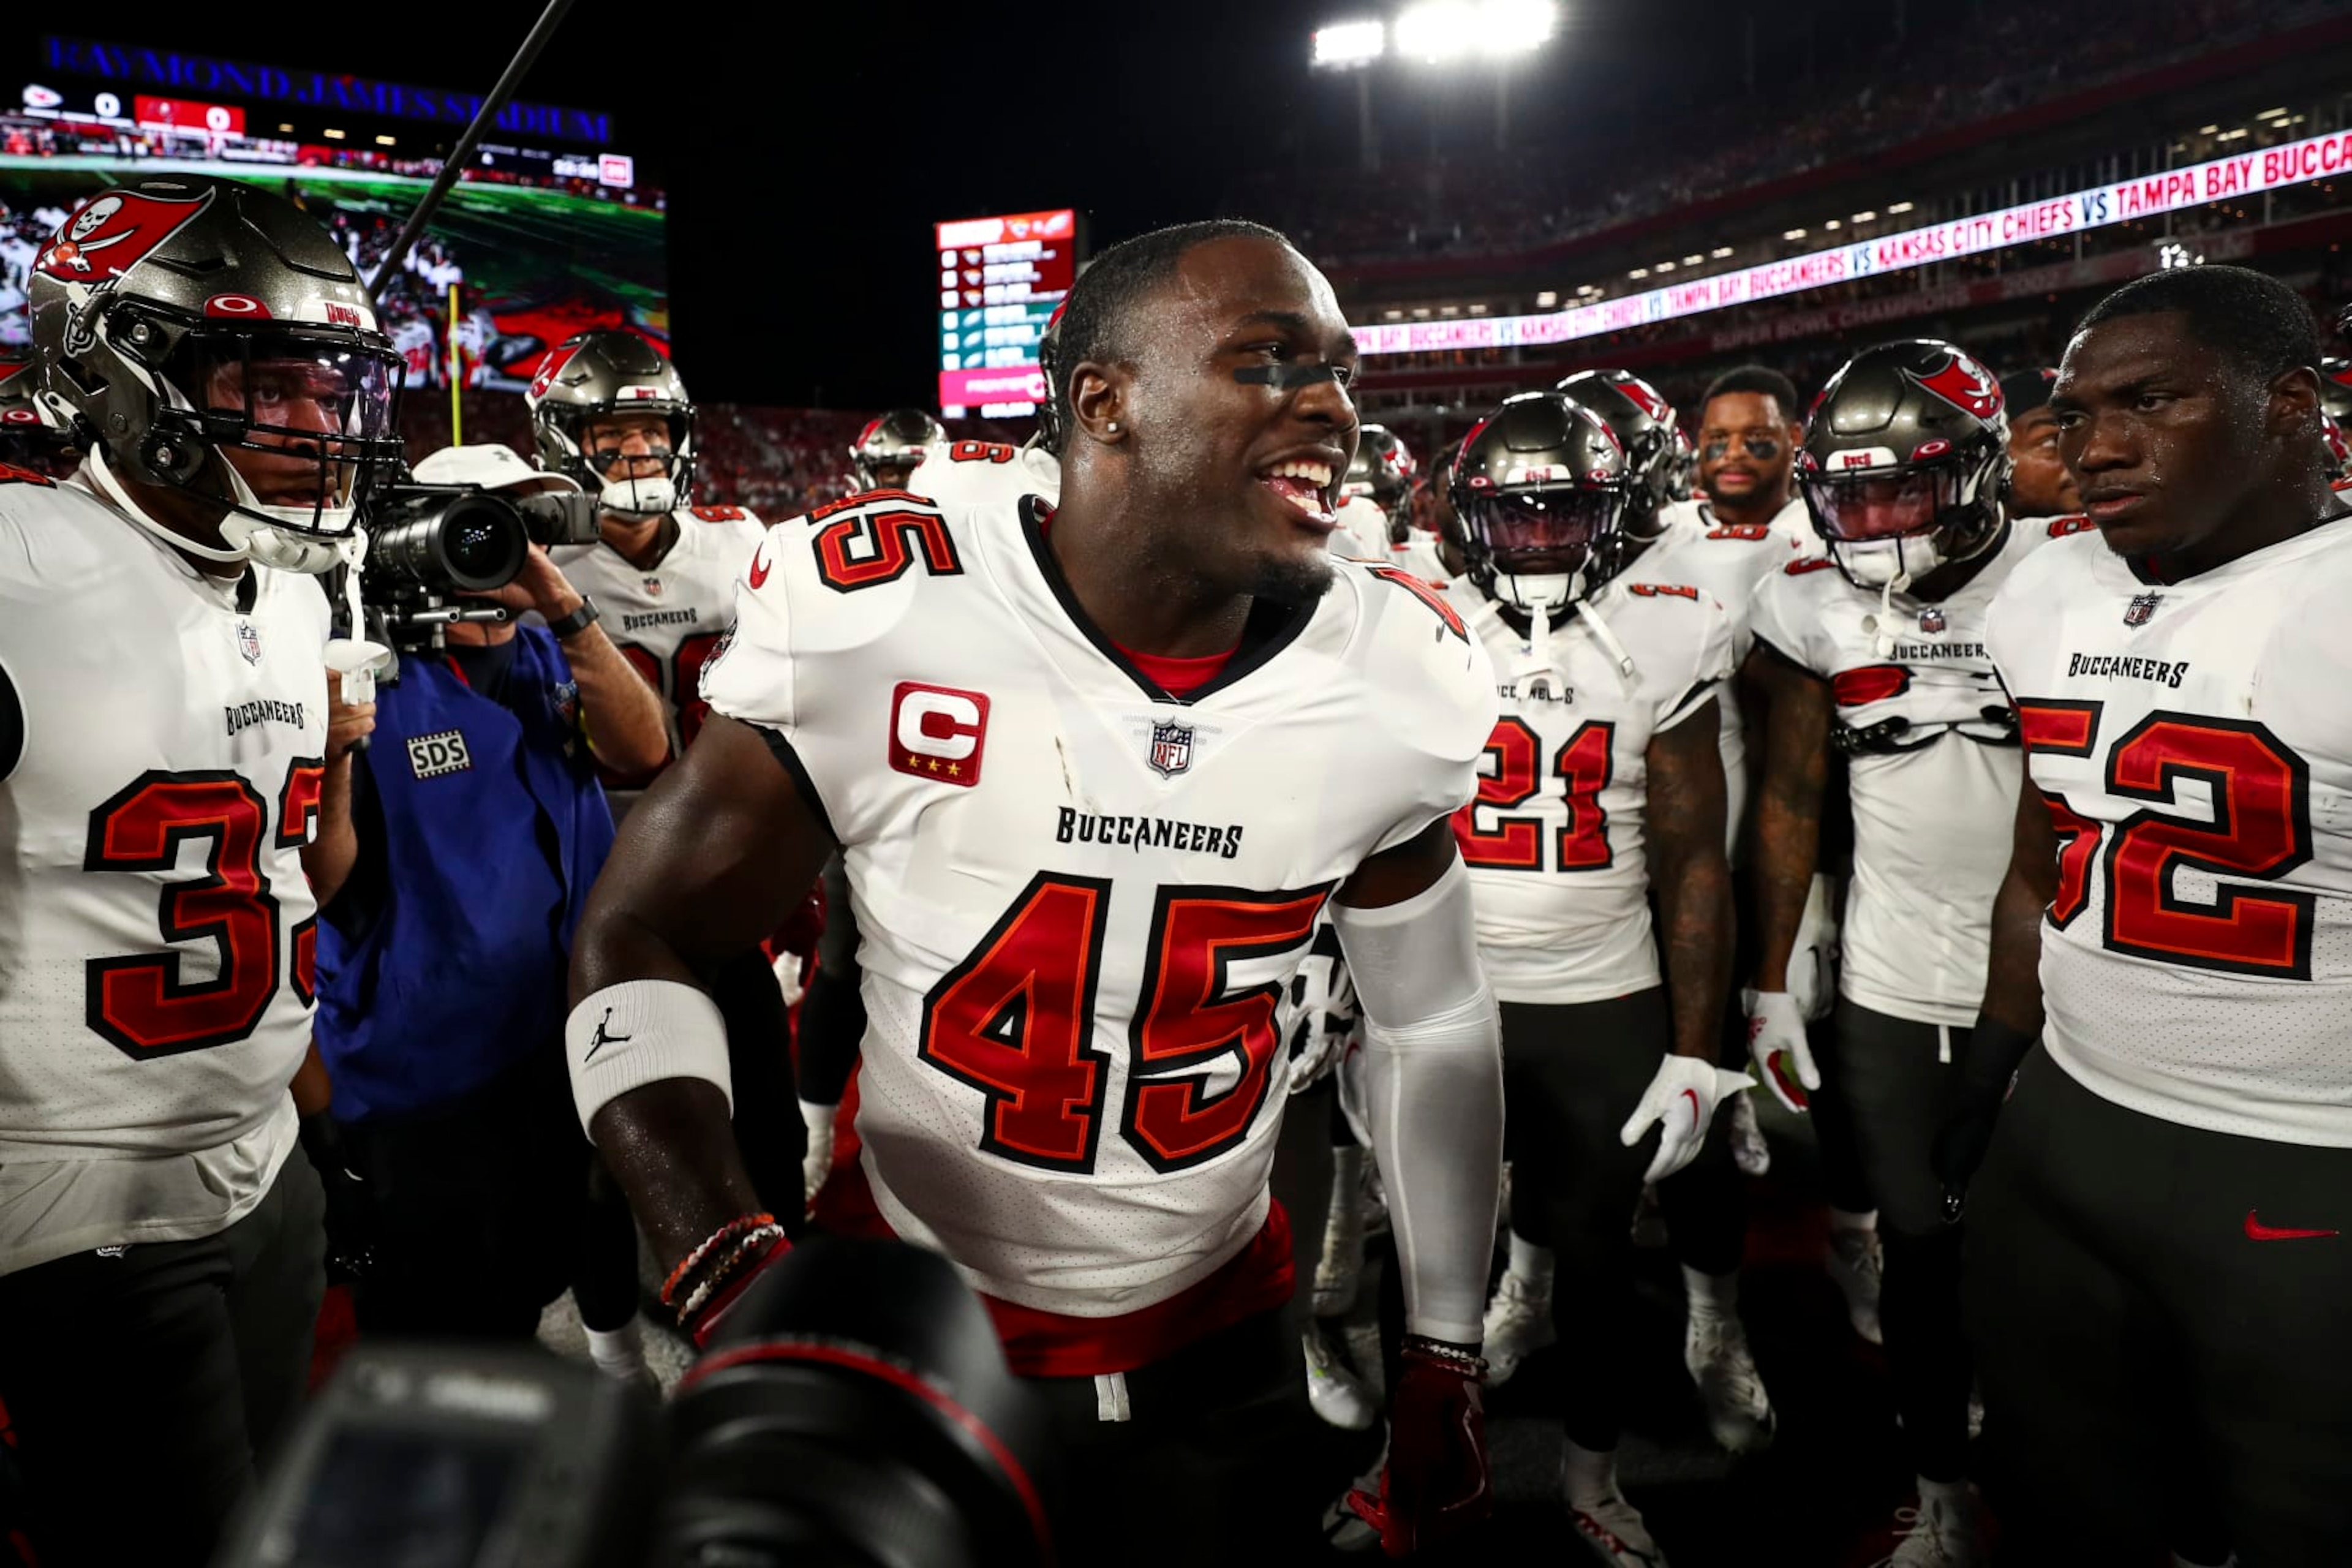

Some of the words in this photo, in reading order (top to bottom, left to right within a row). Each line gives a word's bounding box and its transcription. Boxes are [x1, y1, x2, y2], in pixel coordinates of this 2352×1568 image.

[50, 37, 290, 99] RAYMOND
[296, 73, 437, 118] JAMES
[94, 92, 121, 118] 0
[206, 107, 231, 130] 0
[1749, 251, 1845, 299] BUCCANEERS
[1852, 246, 1872, 273] VS
[1878, 230, 1945, 268] KANSAS
[1953, 219, 1994, 251] CITY
[2002, 200, 2074, 241] CHIEFS
[2081, 192, 2108, 224] VS
[2116, 172, 2195, 217] TAMPA
[2205, 157, 2254, 198] BAY
[1776, 314, 1825, 341] BOWL
[622, 608, 697, 631] BUCCANEERS
[1888, 643, 1991, 661] BUCCANEER
[2068, 652, 2189, 689] BUCCANEERS
[227, 700, 304, 736] BUCCANEERS
[897, 690, 980, 760] C
[412, 737, 465, 771] SDS
[1155, 741, 1186, 768] NFL
[1449, 715, 1615, 873] 21
[1055, 806, 1243, 859] BUCCANEERS
[2015, 697, 2316, 981] 52
[917, 870, 1340, 1175] 45
